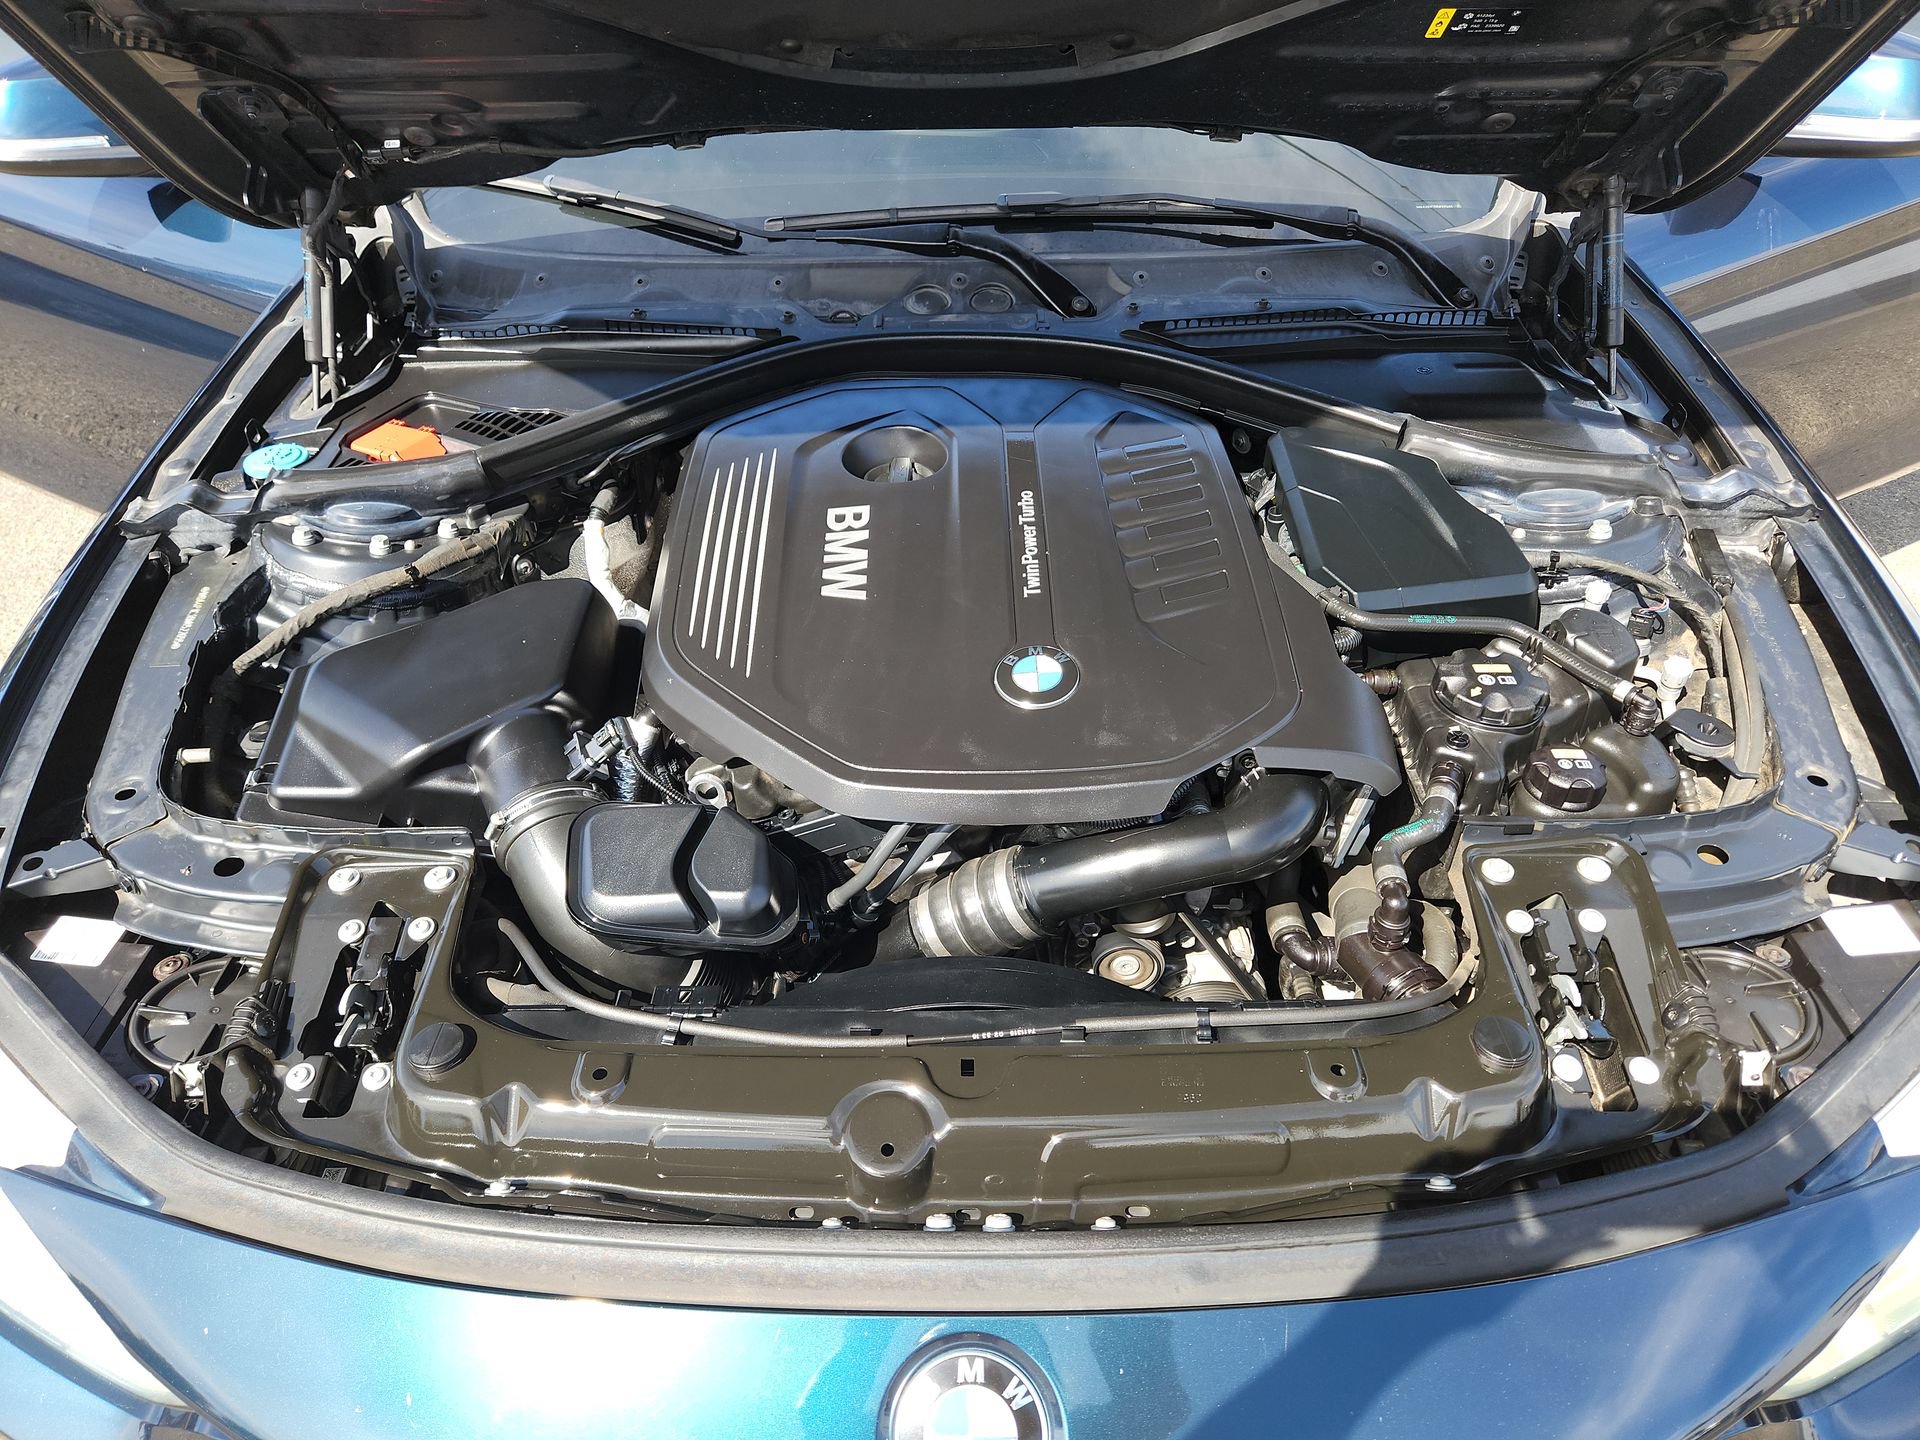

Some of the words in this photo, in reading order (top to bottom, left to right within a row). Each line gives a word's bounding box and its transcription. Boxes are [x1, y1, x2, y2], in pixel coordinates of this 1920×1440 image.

[1017, 490, 1035, 525] Turbo
[821, 504, 871, 600] BMW
[1021, 525, 1041, 598] TwinPower
[1003, 646, 1071, 666] BMW
[957, 1356, 1034, 1411] MW
